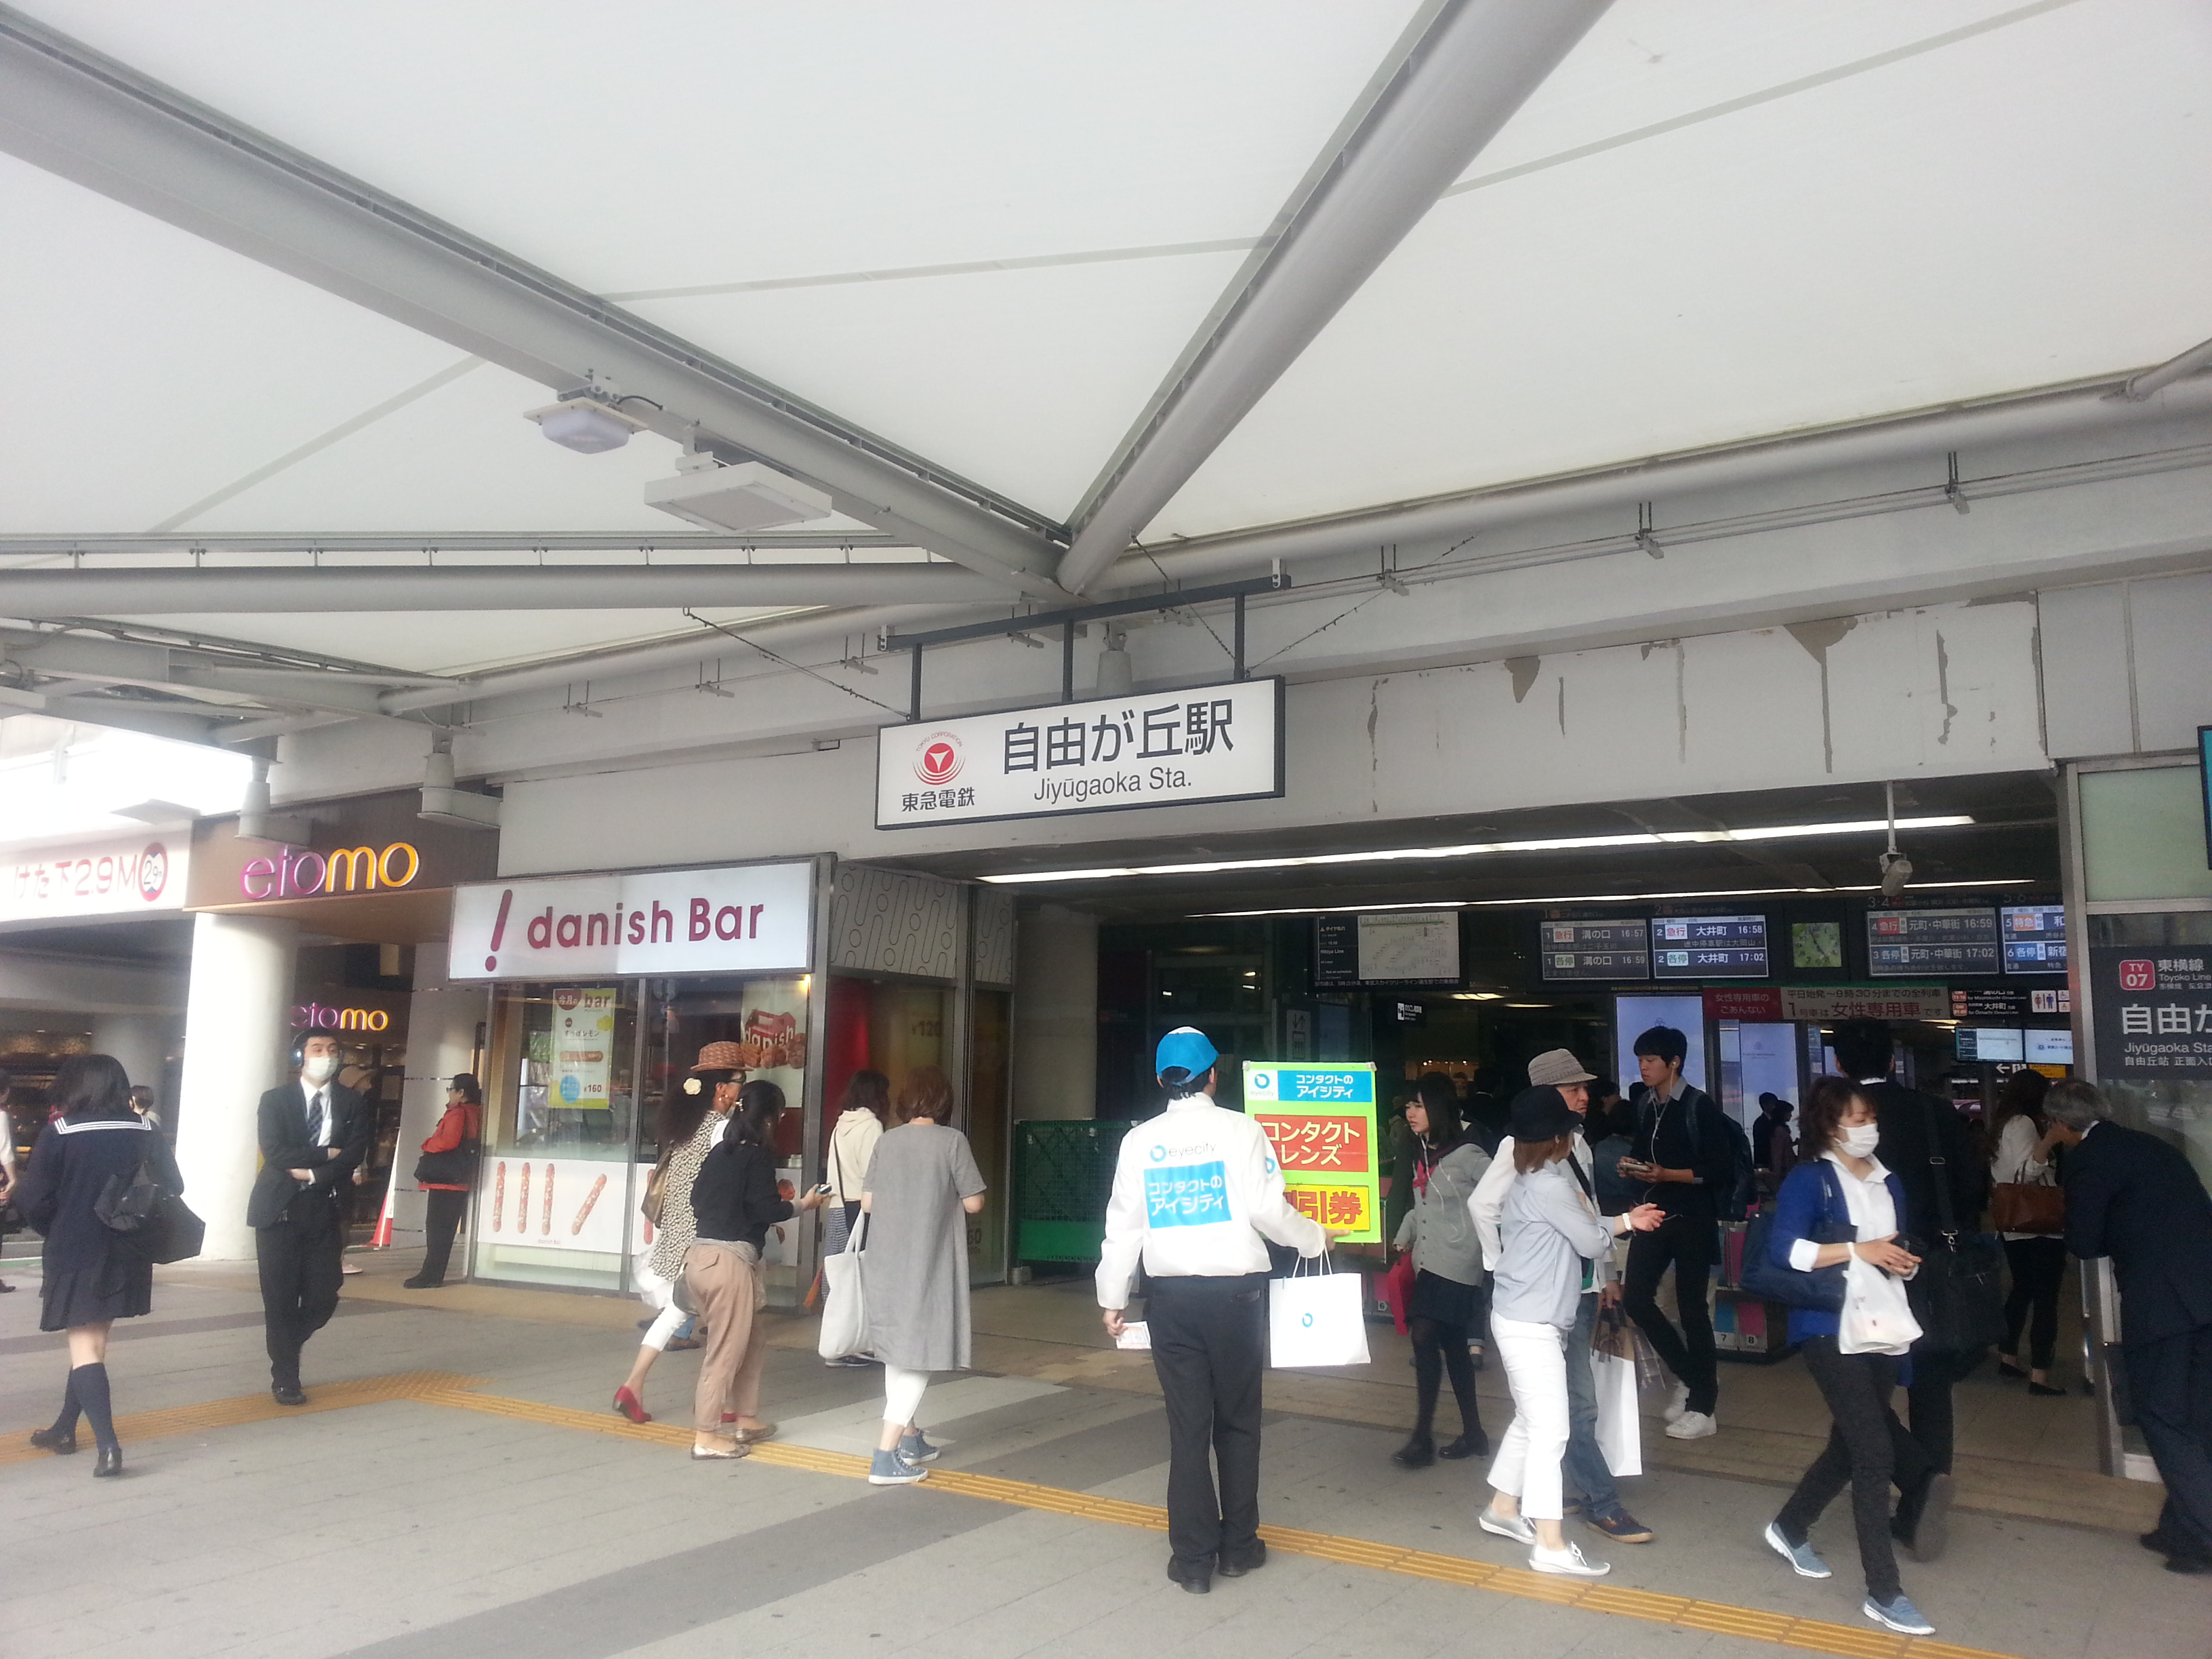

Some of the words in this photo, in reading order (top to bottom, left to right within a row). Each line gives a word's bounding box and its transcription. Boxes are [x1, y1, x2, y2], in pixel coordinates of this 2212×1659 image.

[930, 731, 963, 747] CORPORATION
[1003, 699, 1234, 775] 自由が丘駅
[1033, 773, 1141, 804] Jiyūgaoka
[1149, 767, 1192, 790] Sta.
[901, 787, 975, 812] 東急電鉄
[240, 842, 419, 901] etomo
[527, 900, 674, 949] danish
[689, 898, 764, 942] Bar
[1879, 922, 1898, 931] 急行
[1965, 918, 1993, 928] 16:59
[2005, 918, 2012, 927] 5
[1555, 931, 1573, 940] 急行
[1582, 930, 1611, 940] 溝の口
[1621, 929, 1643, 938] 16:57
[1666, 928, 1686, 937] 急行
[1696, 926, 1727, 937] 大井町
[1738, 926, 1763, 935] 16:58
[1668, 955, 1687, 964] 各停
[1698, 954, 1729, 964] 大井町
[1740, 953, 1764, 962] 17:02
[1873, 951, 1879, 959] 3
[1881, 949, 1900, 960] 各停
[1966, 948, 1994, 958] 17:02
[2007, 948, 2014, 957] 6
[2017, 947, 2036, 958] 各停
[1583, 956, 1612, 966] 溝の口
[1622, 956, 1645, 964] 16:59
[2129, 964, 2145, 972] TY
[2158, 958, 2205, 972] 東横線
[2126, 974, 2148, 987] 07
[584, 993, 610, 1008] bar
[1715, 994, 1769, 1002] 女性専用車の
[291, 1002, 388, 1032] etomo
[744, 1025, 794, 1050] danish
[1296, 1074, 1353, 1084] コンタクトの
[1296, 1086, 1353, 1099] アイシティ
[1261, 1122, 1360, 1144] コンタクト
[1168, 1141, 1216, 1160] eyecity
[1281, 1144, 1343, 1166] レンズ
[1149, 1175, 1223, 1195] コンタクトの
[1150, 1193, 1224, 1216] アイシティ
[1283, 1190, 1364, 1225] 引券
